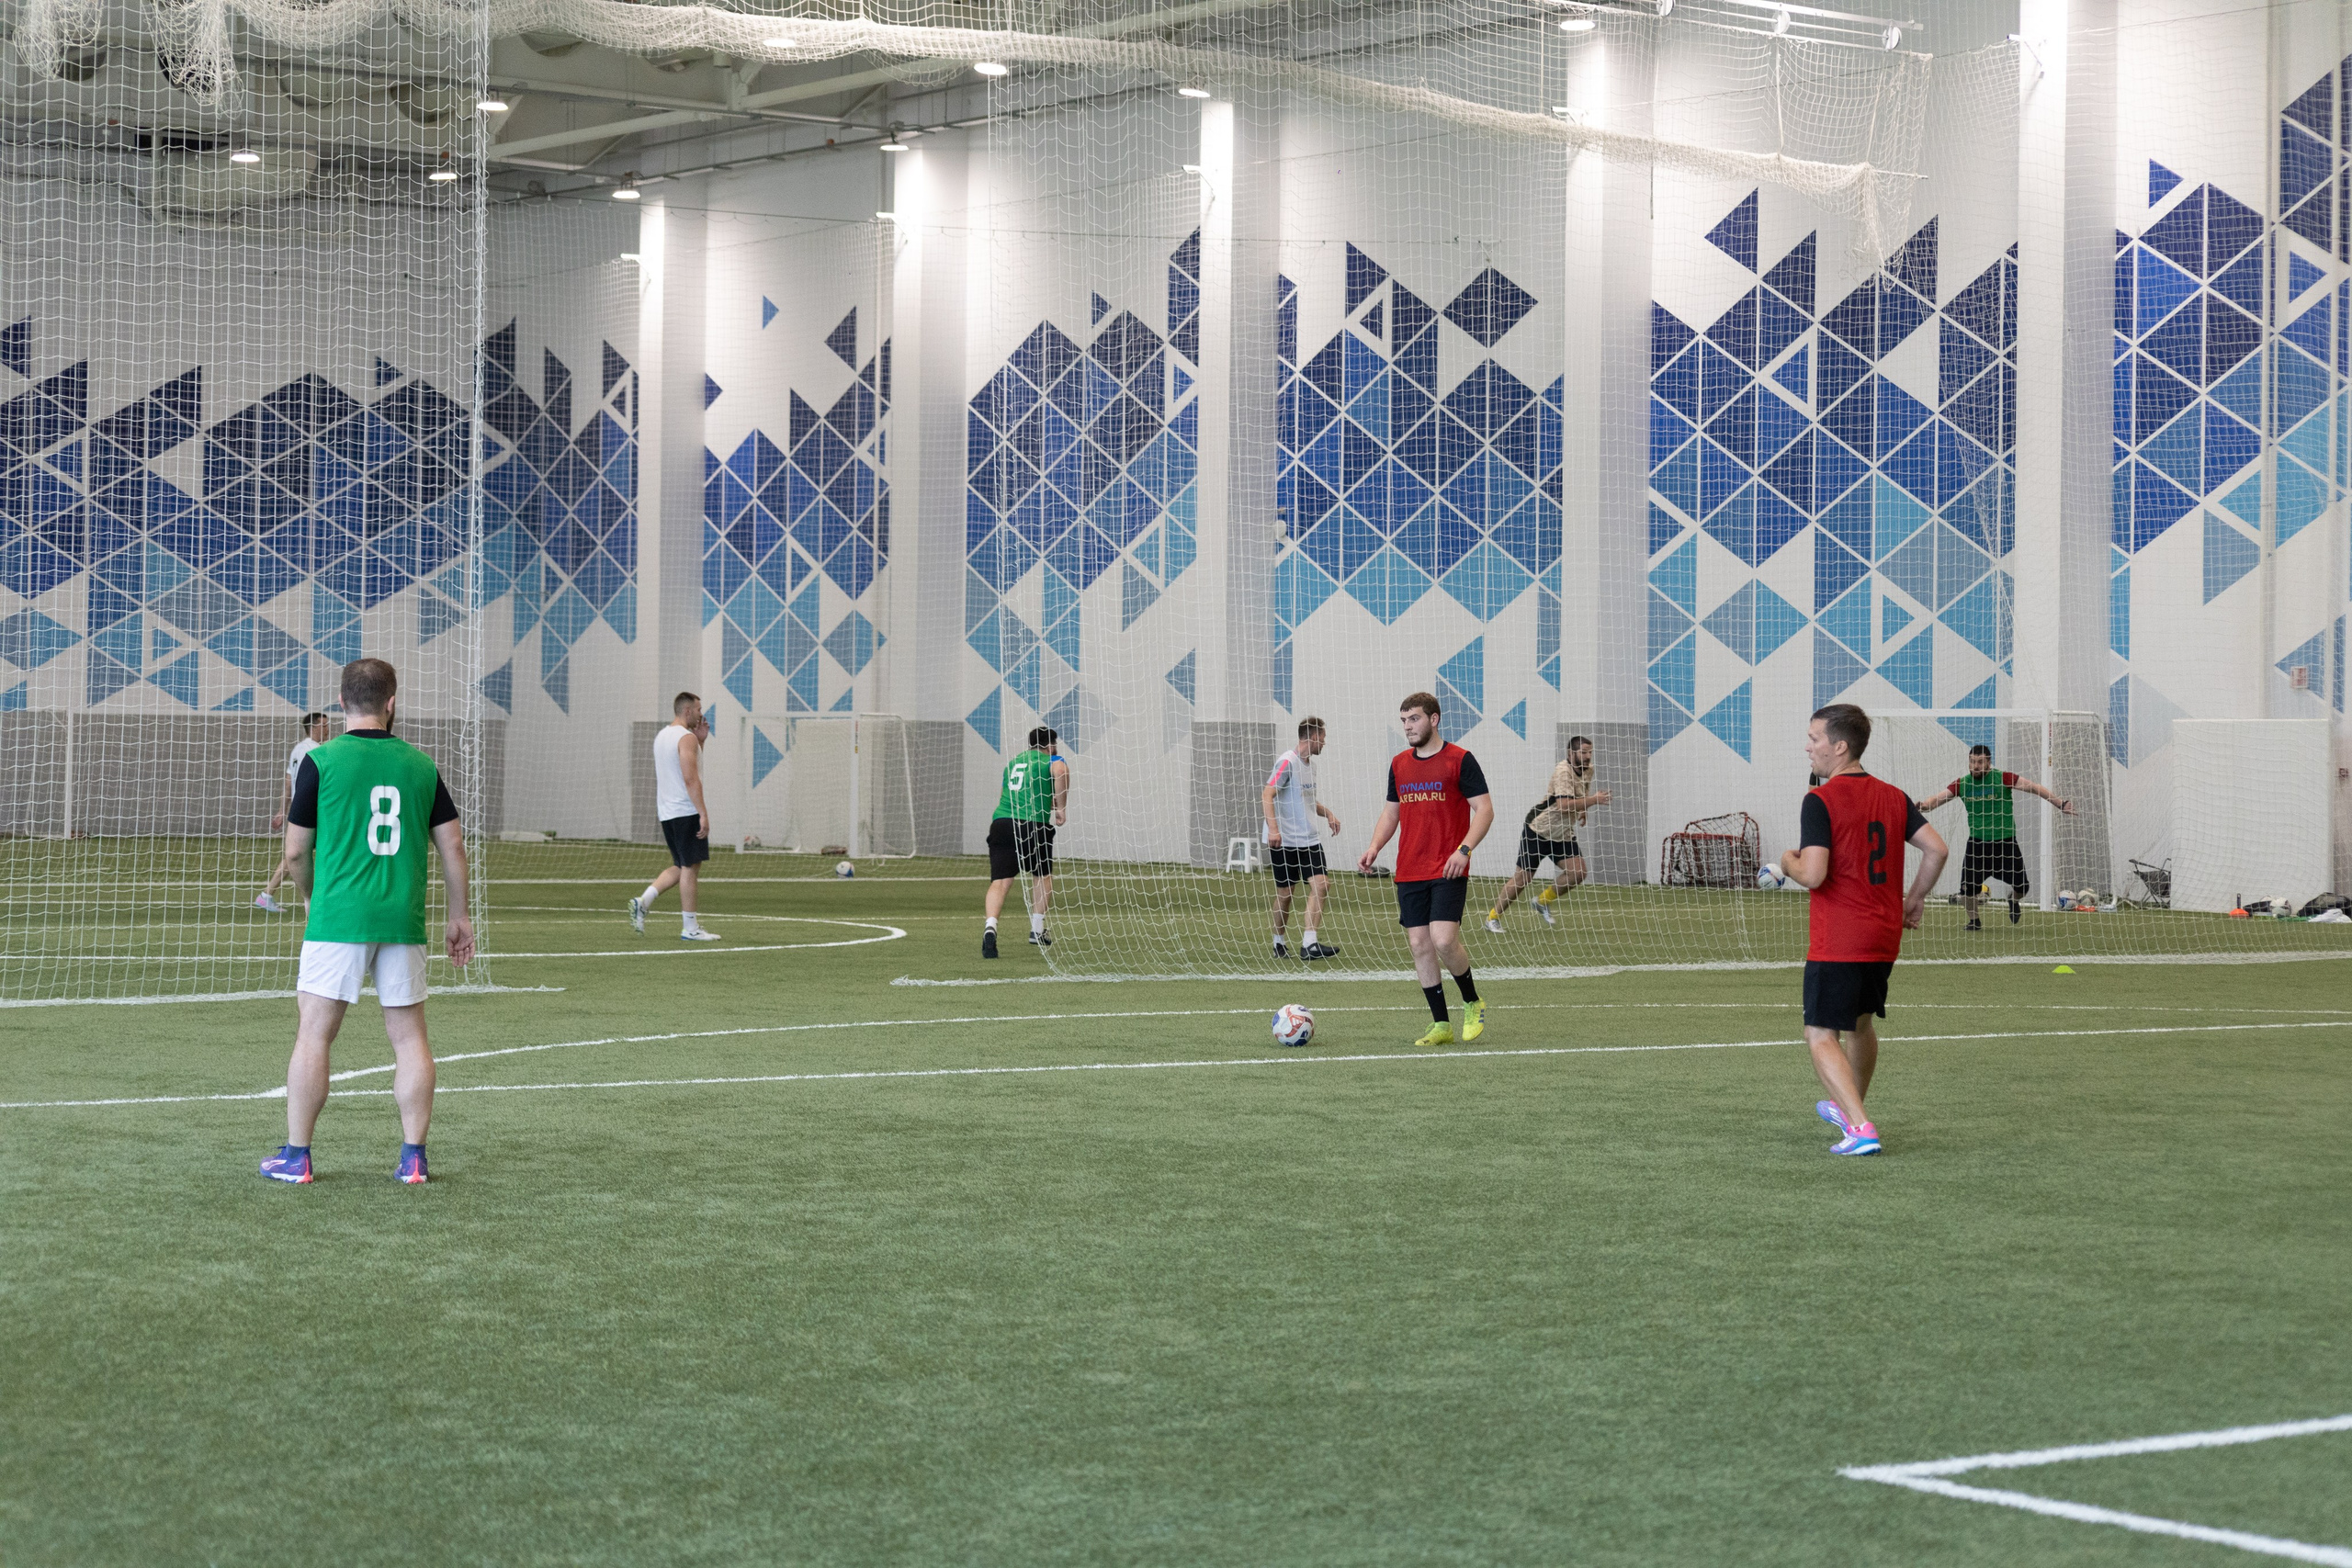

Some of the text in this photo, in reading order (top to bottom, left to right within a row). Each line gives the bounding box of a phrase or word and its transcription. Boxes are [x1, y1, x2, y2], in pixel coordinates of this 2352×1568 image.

[1008, 762, 1028, 791] 5
[1399, 781, 1442, 795] DYNAMO
[1399, 792, 1446, 804] ARENA.RU
[368, 784, 401, 856] 8
[1868, 820, 1887, 886] 2
